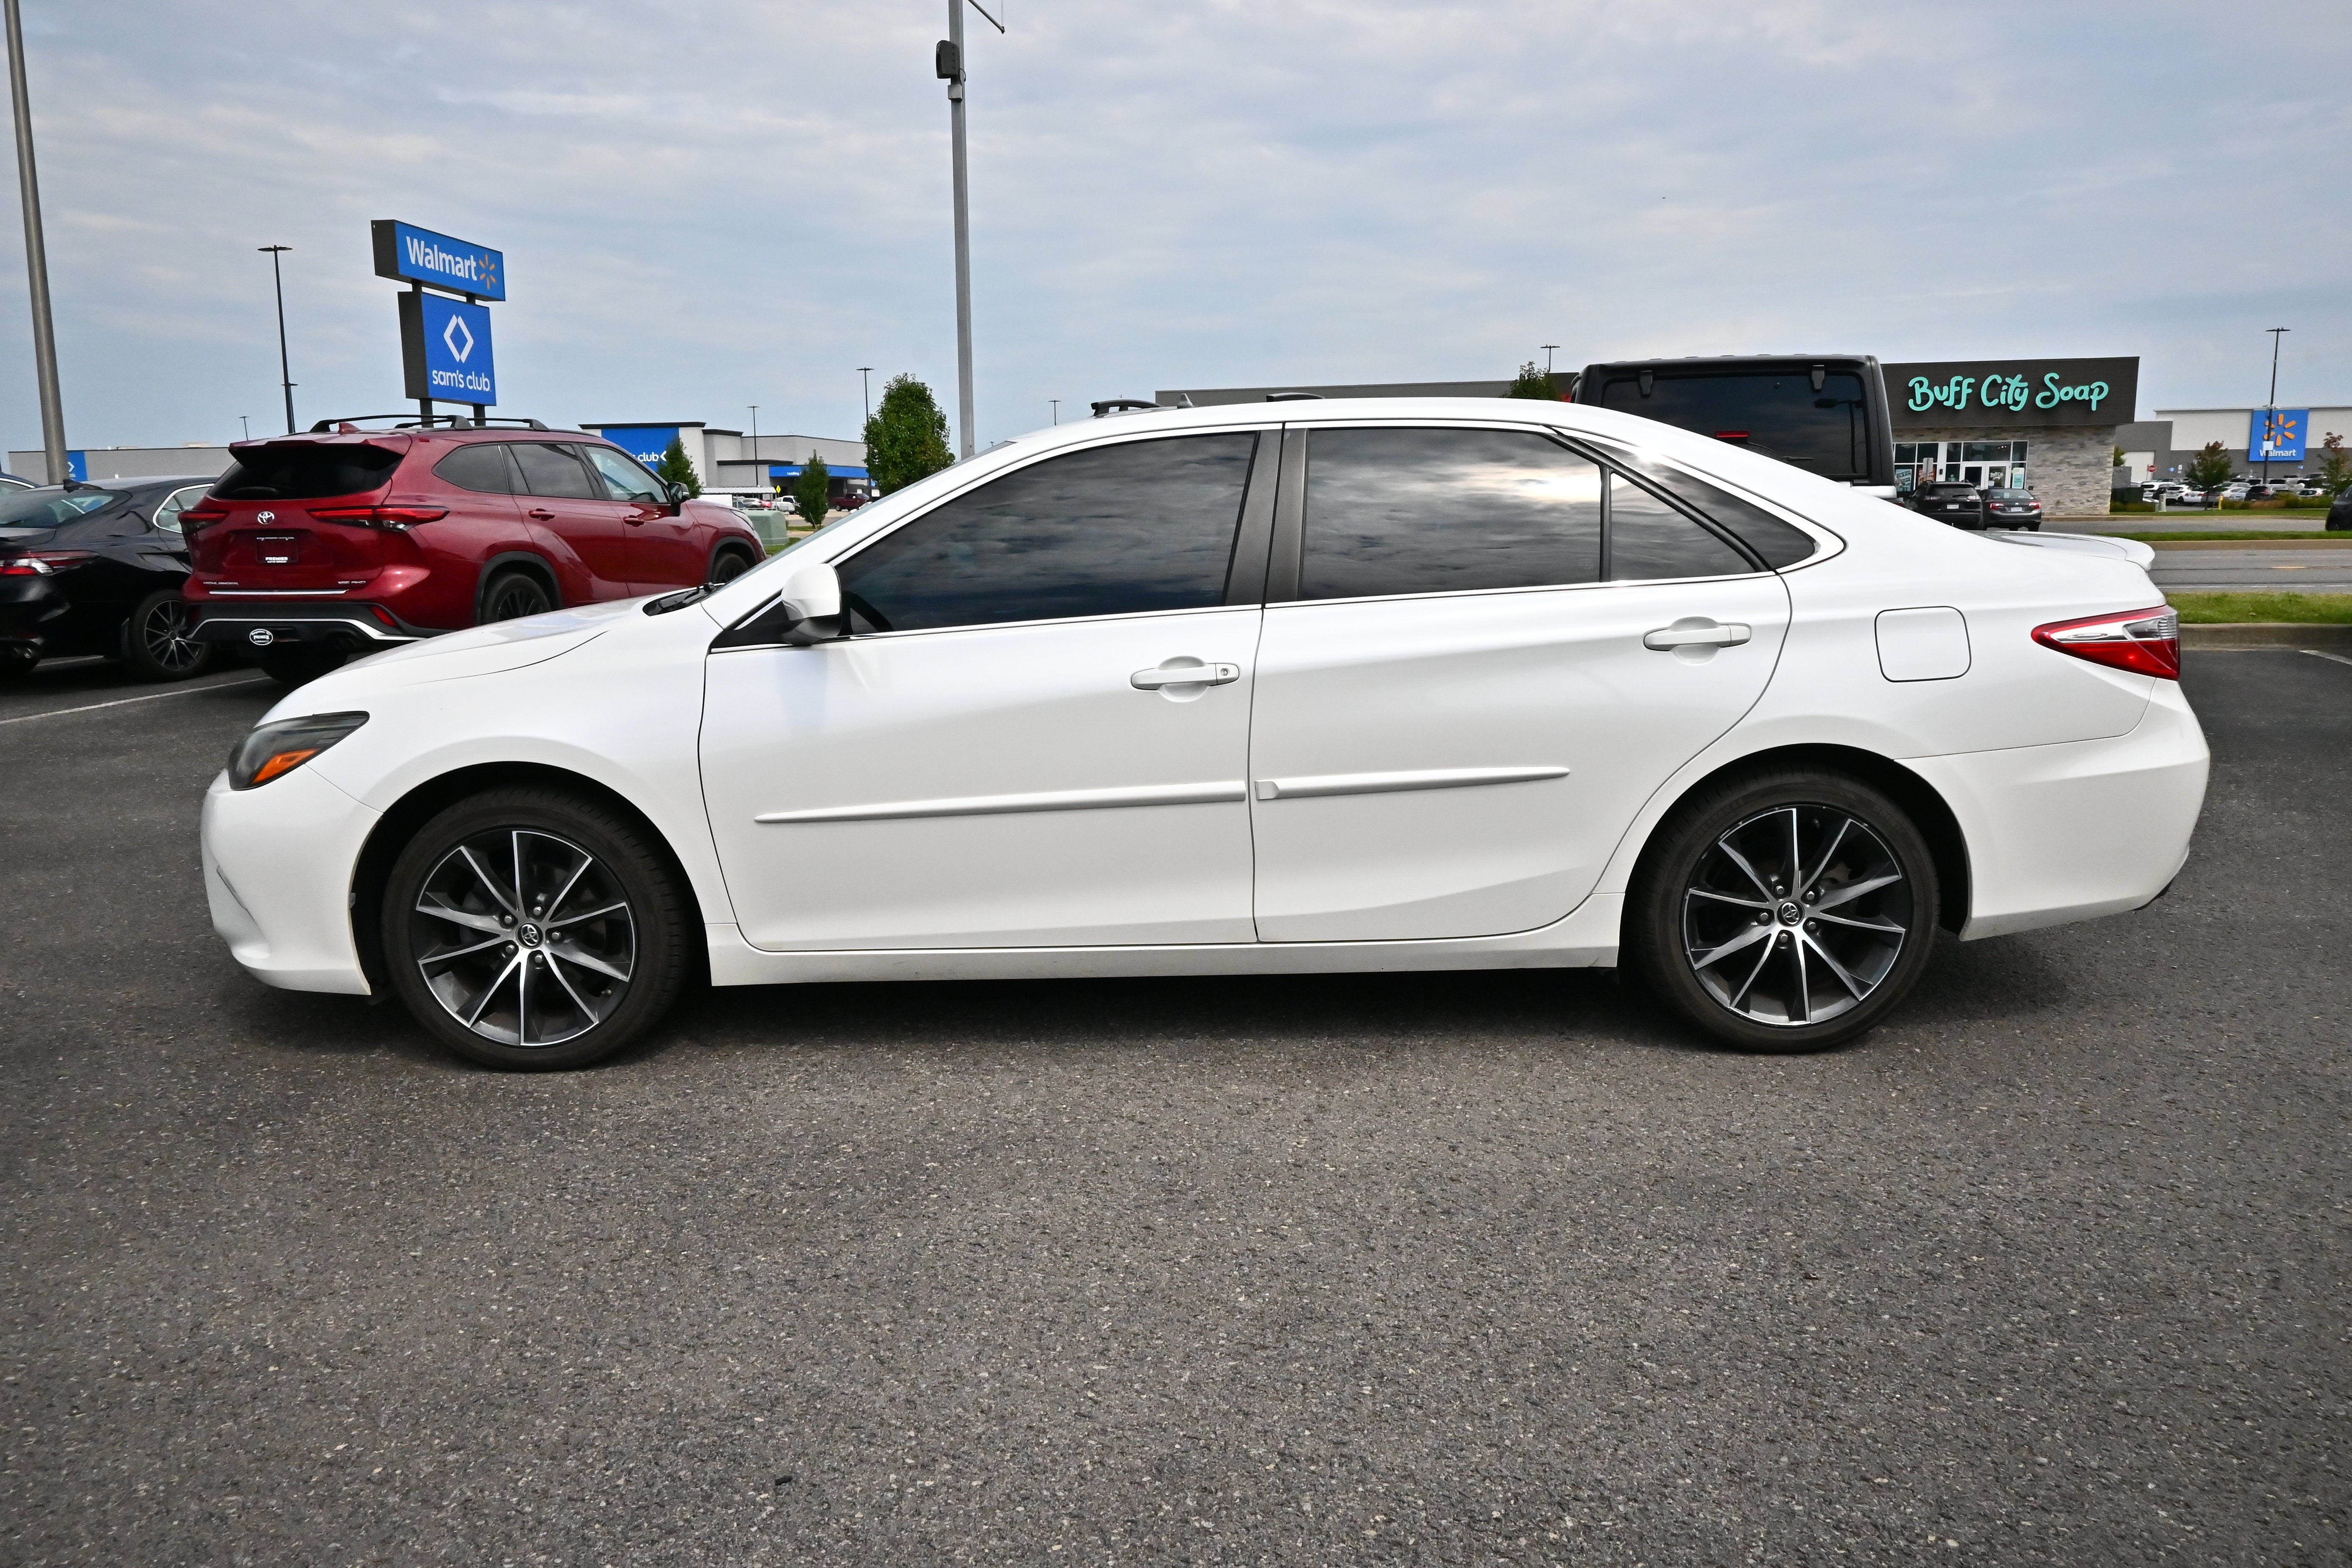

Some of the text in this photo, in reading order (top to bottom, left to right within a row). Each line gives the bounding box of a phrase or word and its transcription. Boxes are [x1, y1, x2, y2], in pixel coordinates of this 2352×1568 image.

[406, 236, 477, 281] Walmart
[432, 369, 490, 392] sam's club
[1908, 372, 2109, 411] Buff City Soap
[637, 452, 659, 462] club
